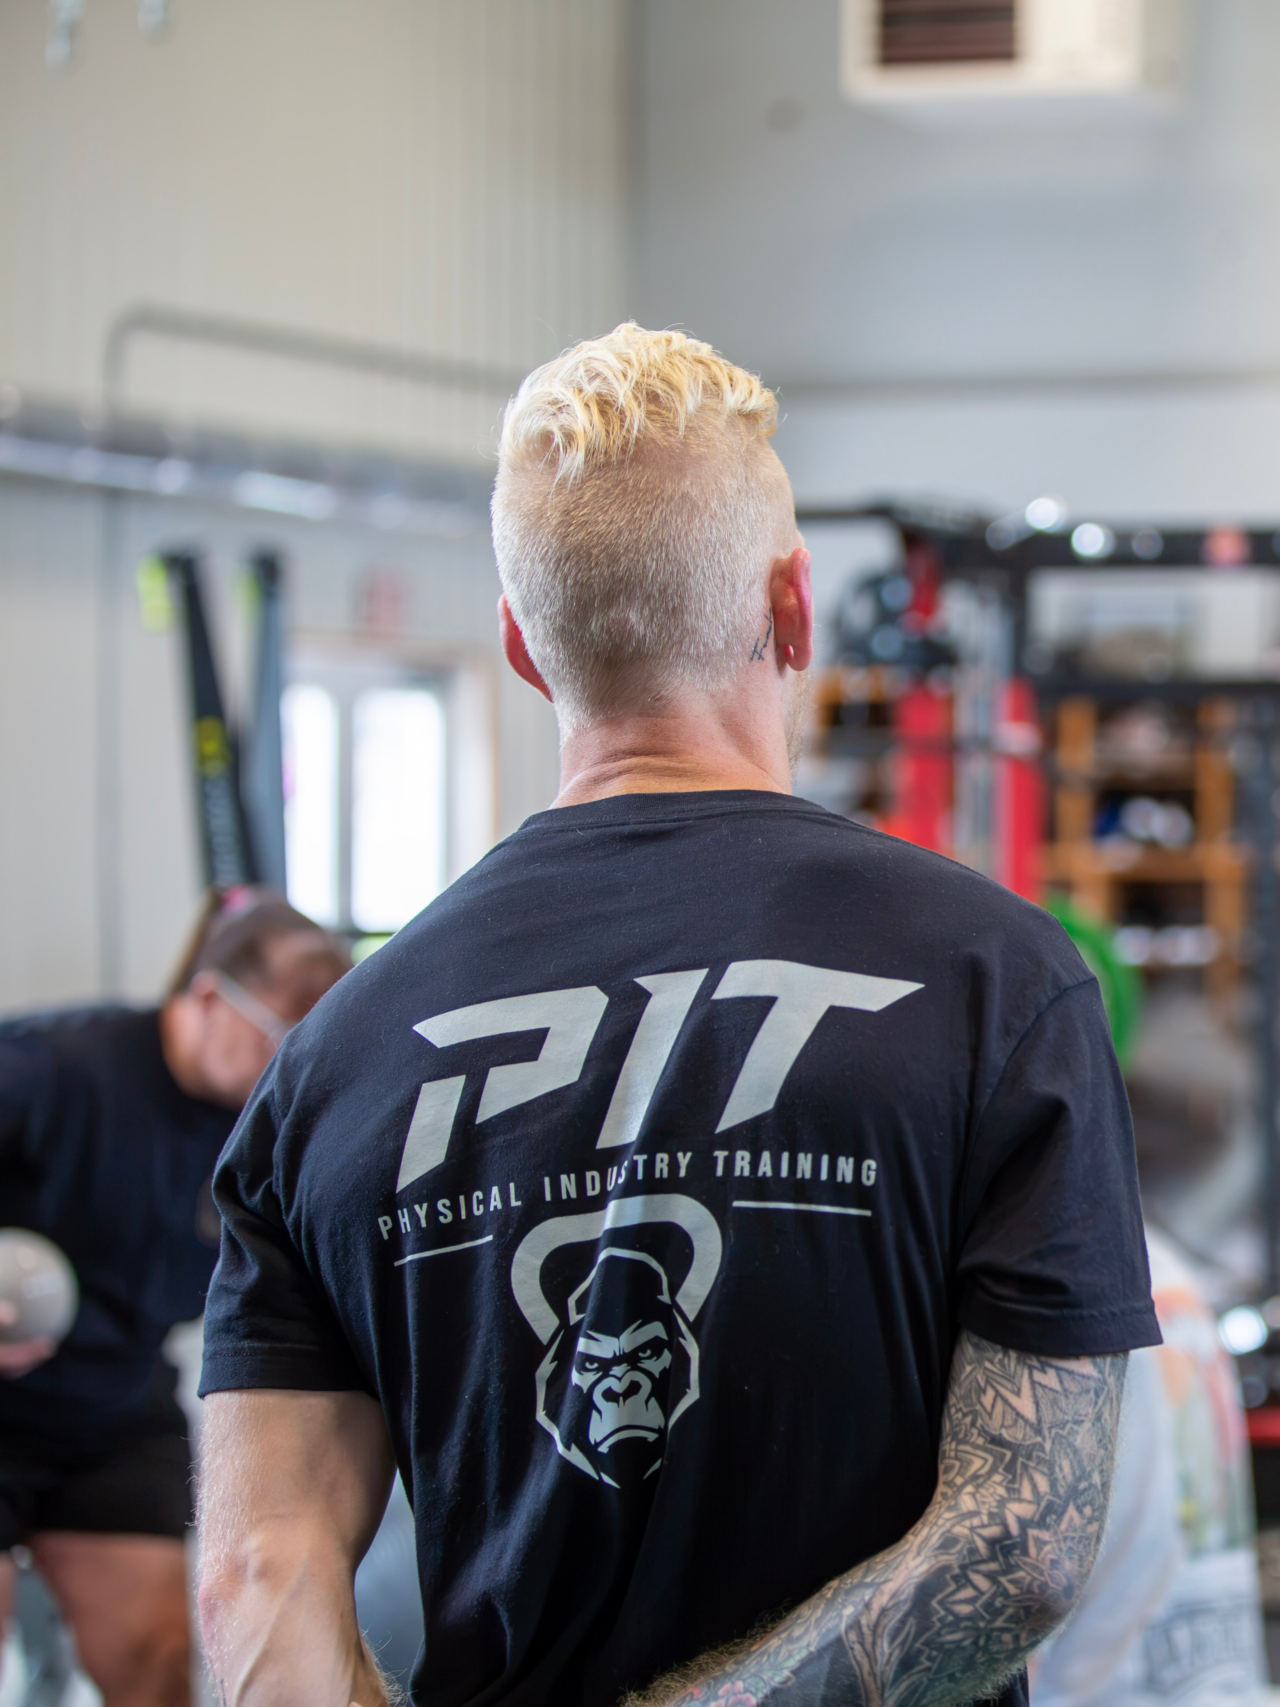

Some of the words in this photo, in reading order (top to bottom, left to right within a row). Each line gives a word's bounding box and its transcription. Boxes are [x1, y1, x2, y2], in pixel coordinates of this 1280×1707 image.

[396, 959, 925, 1193] PIT
[378, 1182, 522, 1241] PHYSICAL
[544, 1152, 692, 1202] INDUSTRY
[714, 1150, 878, 1187] TRAINING
